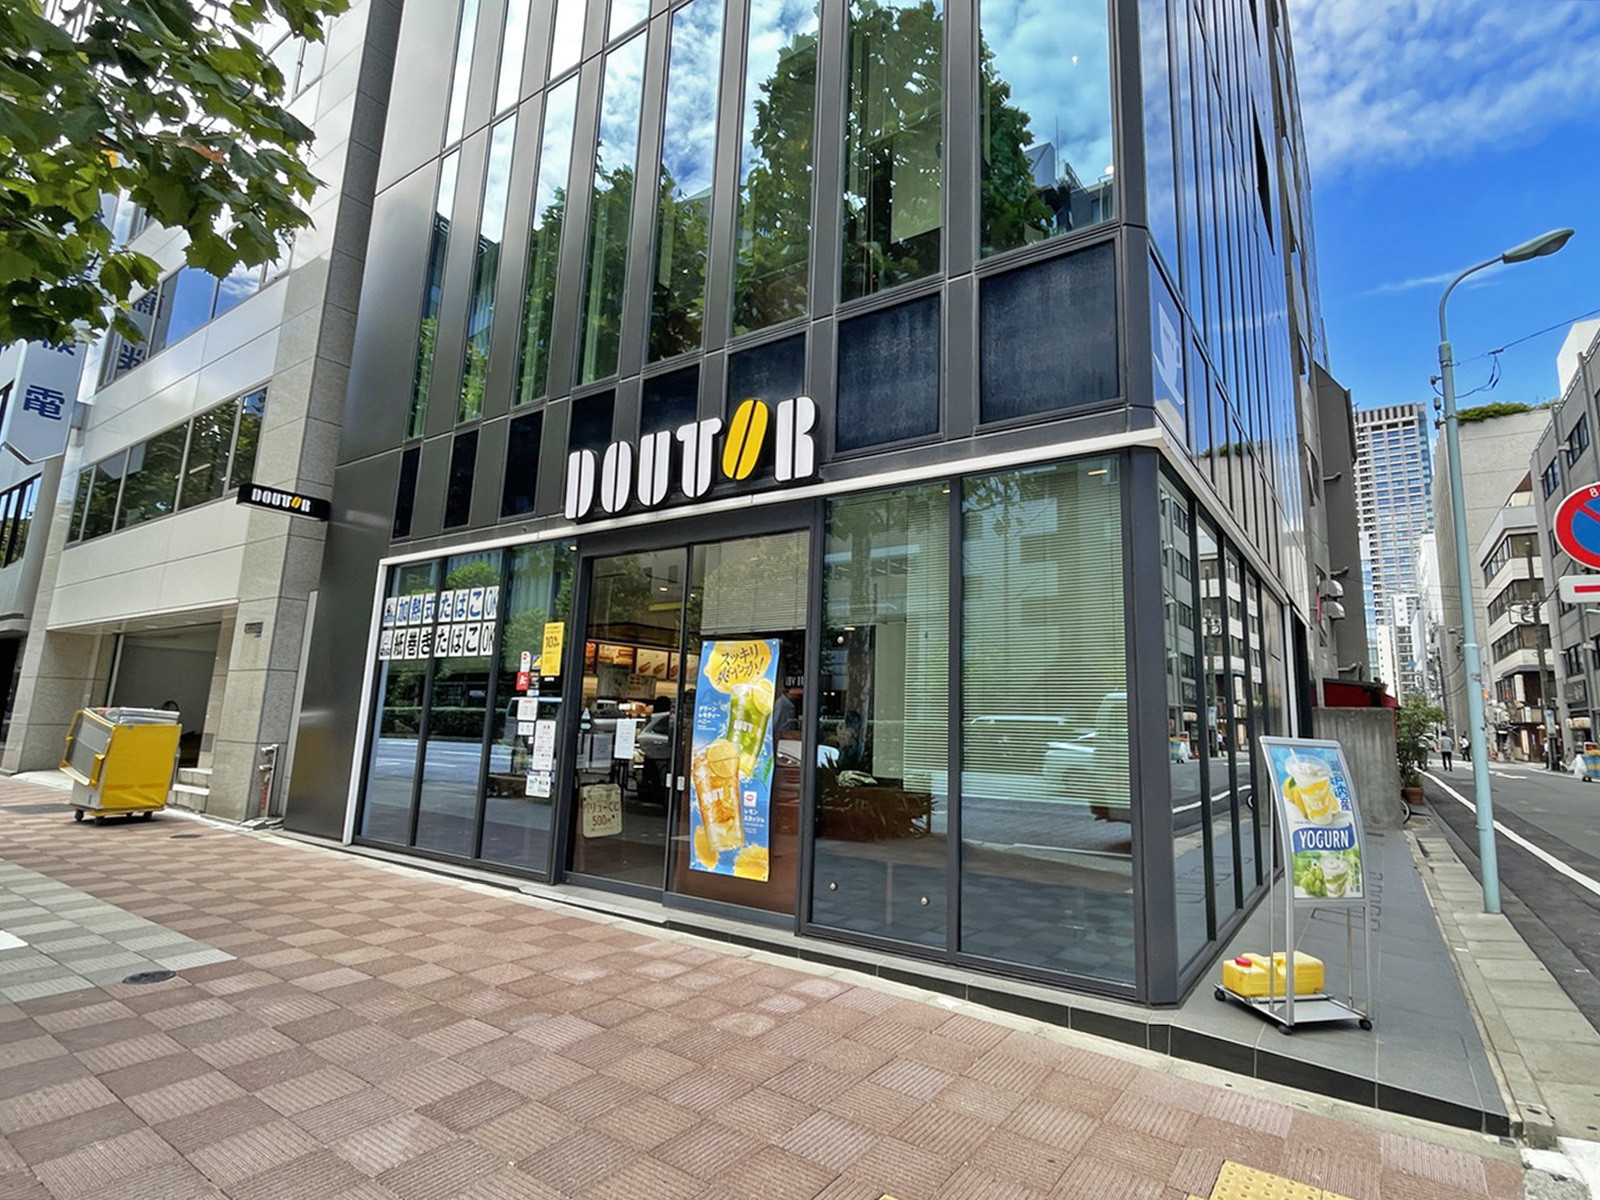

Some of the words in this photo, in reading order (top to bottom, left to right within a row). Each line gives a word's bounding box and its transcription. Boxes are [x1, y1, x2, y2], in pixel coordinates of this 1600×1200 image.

[23, 384, 65, 421] 電
[564, 396, 817, 520] DOUTOR
[251, 488, 312, 513] DOUTOR
[716, 643, 760, 670] スッキリ
[1298, 829, 1349, 849] YOGURN
